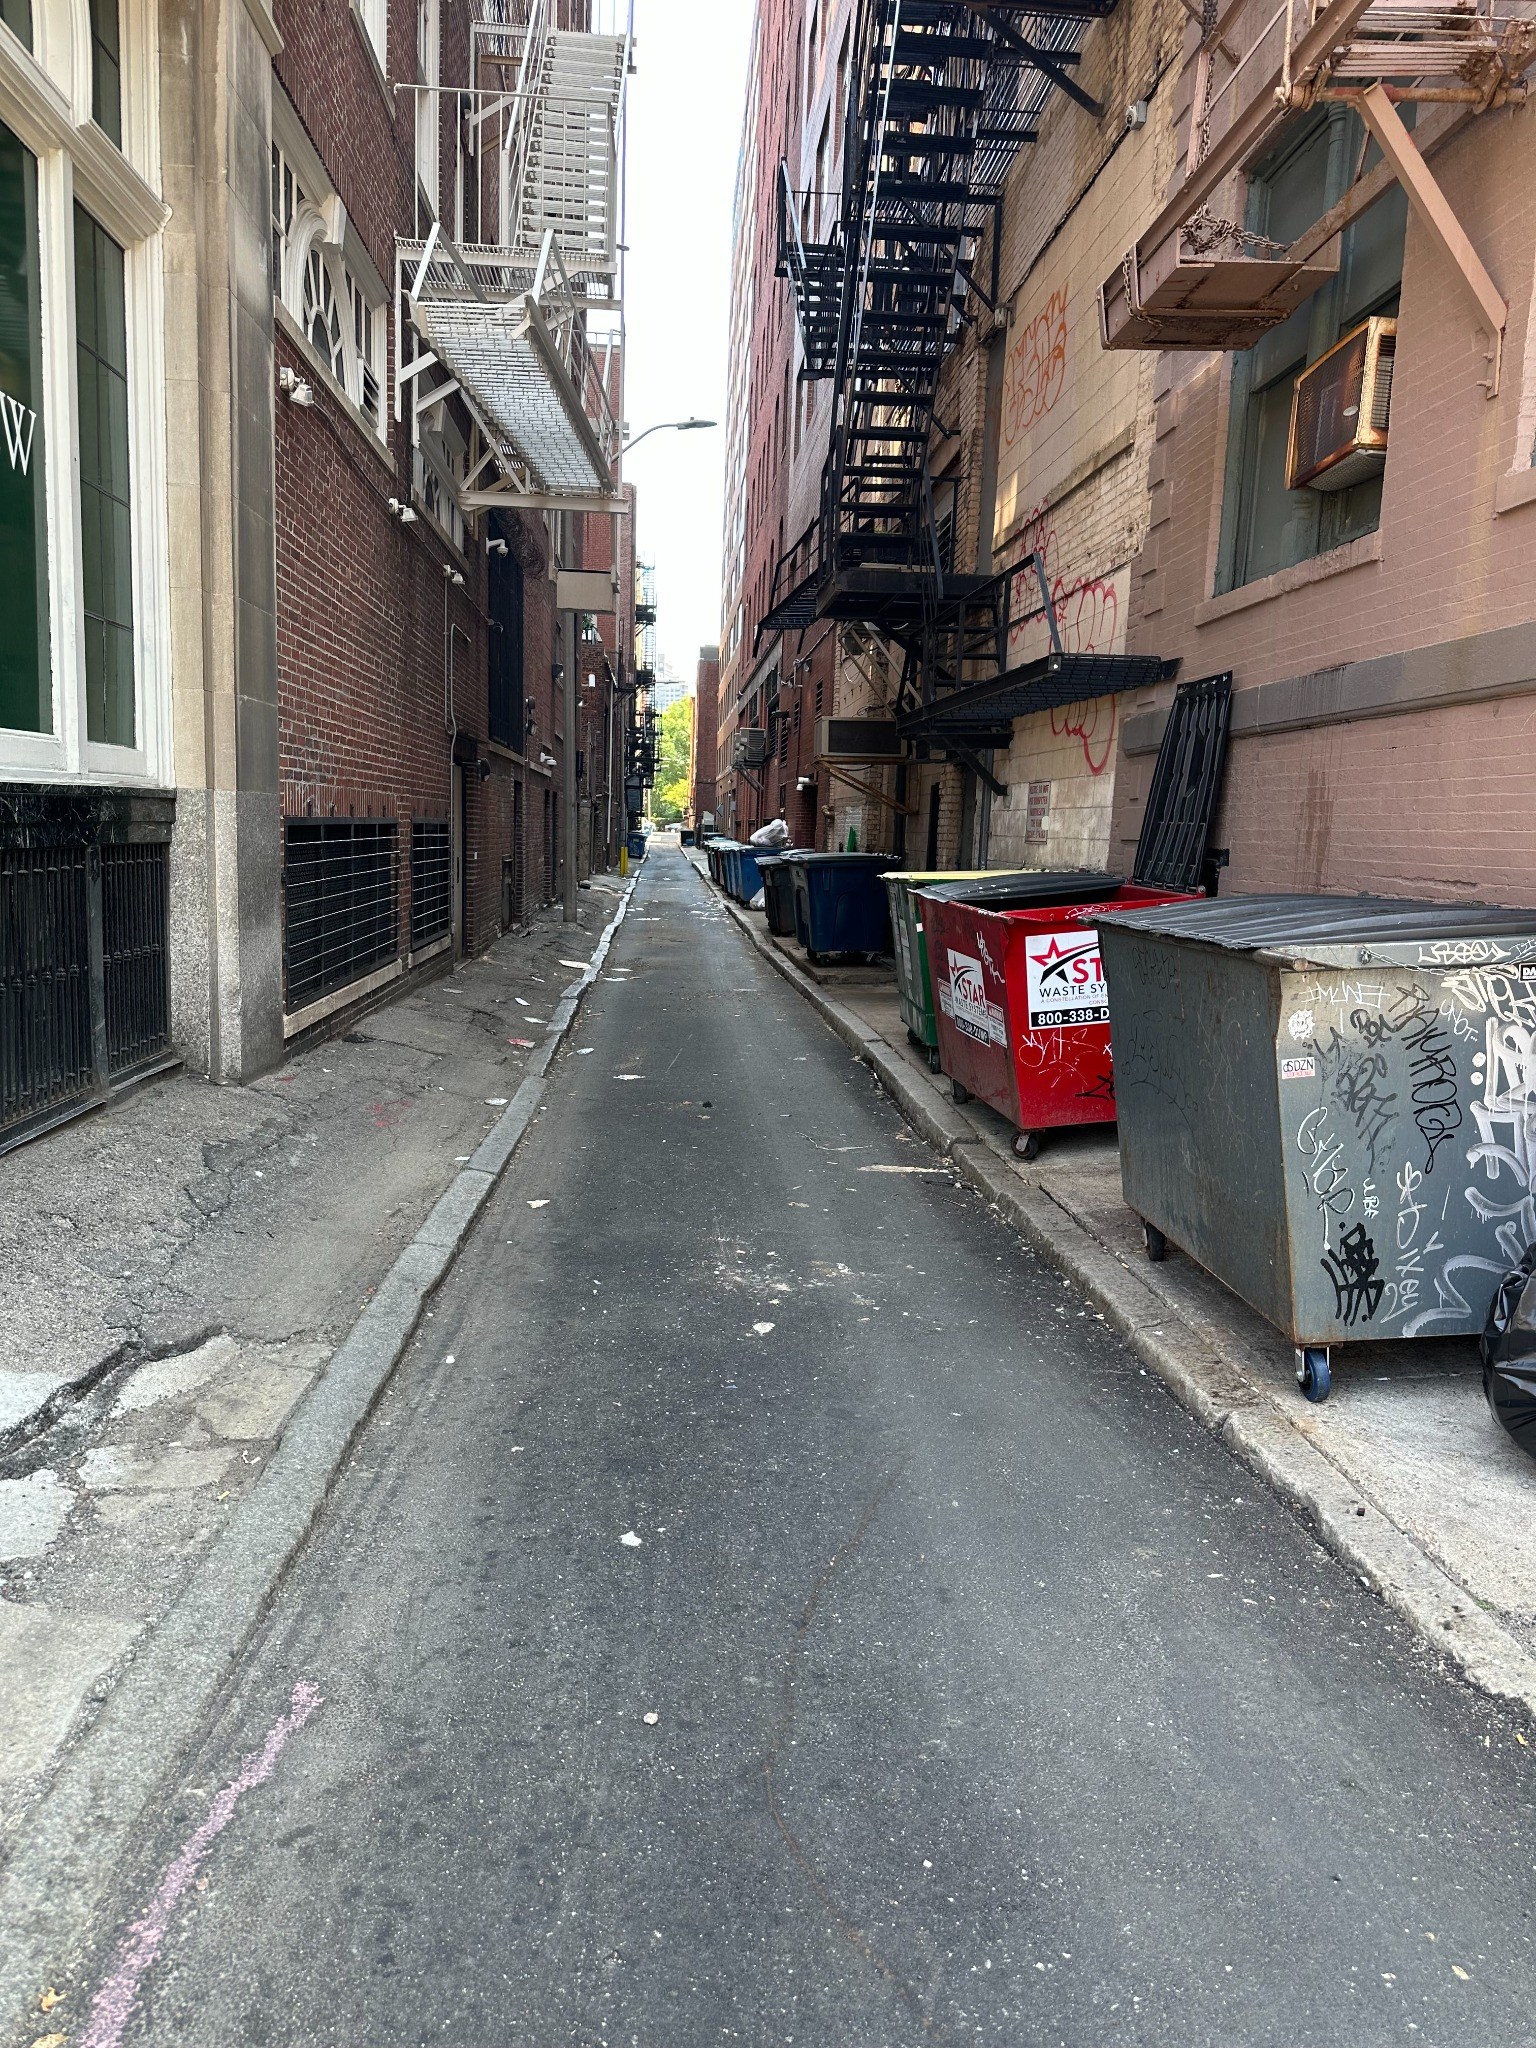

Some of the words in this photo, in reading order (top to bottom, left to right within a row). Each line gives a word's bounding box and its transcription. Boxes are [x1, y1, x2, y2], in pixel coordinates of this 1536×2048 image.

[0, 391, 37, 476] W
[962, 977, 986, 1008] STAR
[1039, 984, 1086, 998] WASTE
[1037, 1007, 1109, 1025] 800-338-D
